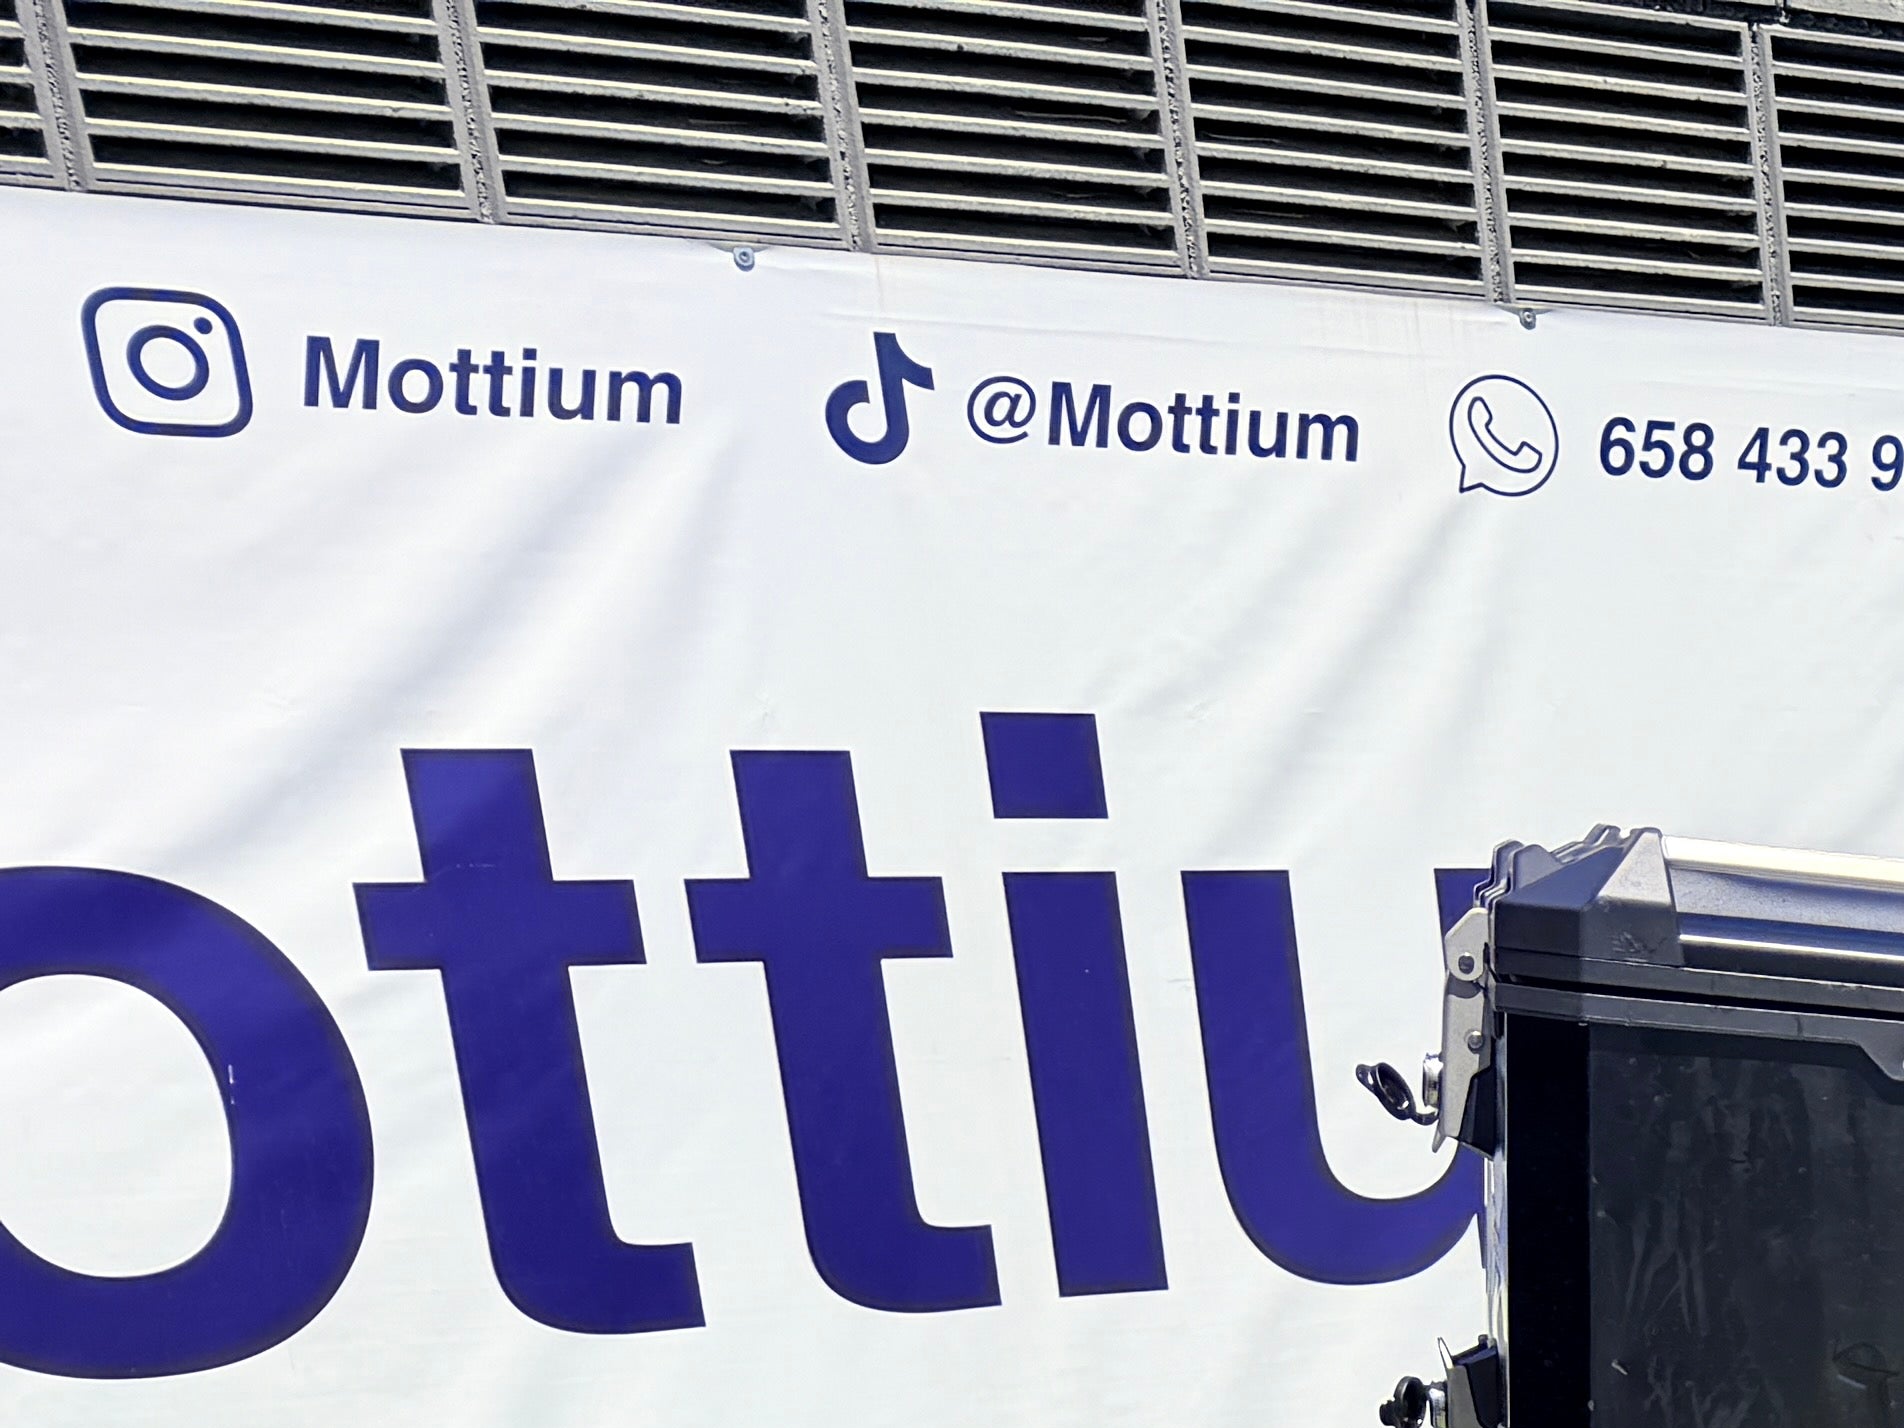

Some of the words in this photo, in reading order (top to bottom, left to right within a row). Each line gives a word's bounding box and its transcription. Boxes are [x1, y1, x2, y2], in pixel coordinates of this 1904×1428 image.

[302, 334, 685, 425] Mottium
[965, 374, 1361, 463] @Mottium
[1598, 415, 1716, 482] 658
[1736, 426, 1850, 490] 433
[0, 710, 1484, 1380] ottiu
